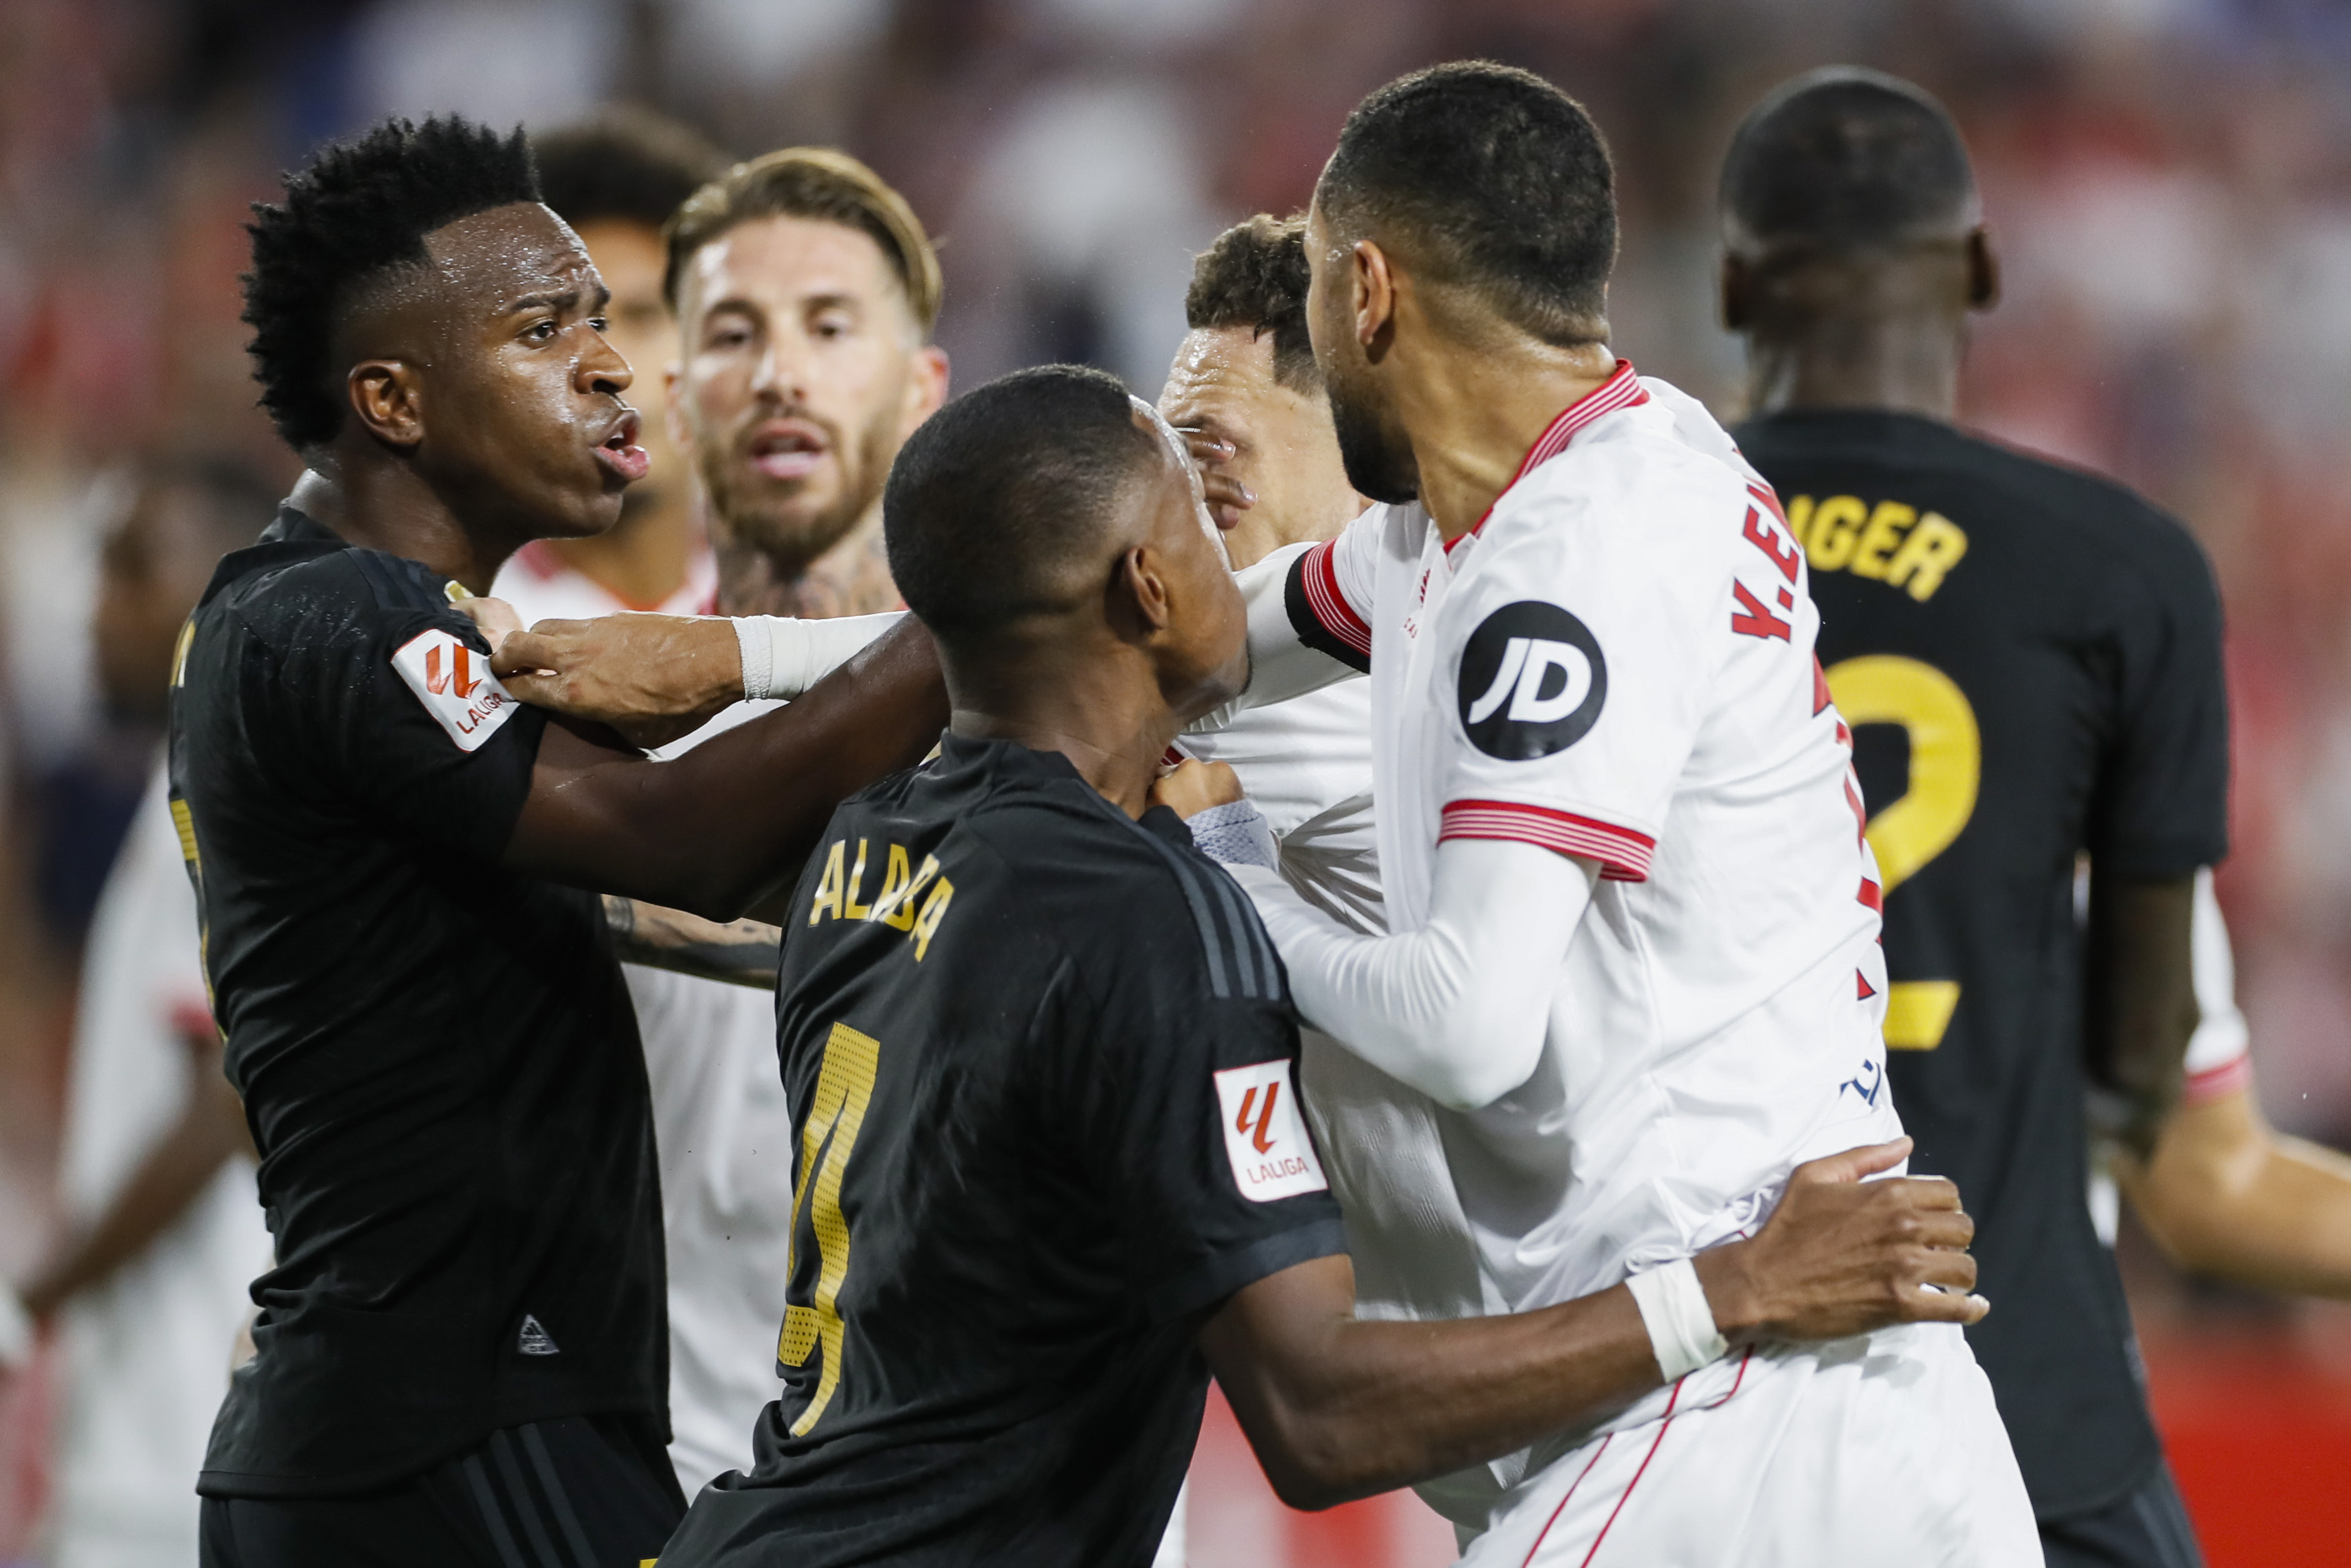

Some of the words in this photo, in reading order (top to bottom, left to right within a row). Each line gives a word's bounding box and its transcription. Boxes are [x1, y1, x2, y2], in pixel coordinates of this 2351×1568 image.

[1468, 636, 1592, 724] JD
[456, 693, 505, 734] LALIGA
[1246, 1157, 1309, 1184] LALIGA
